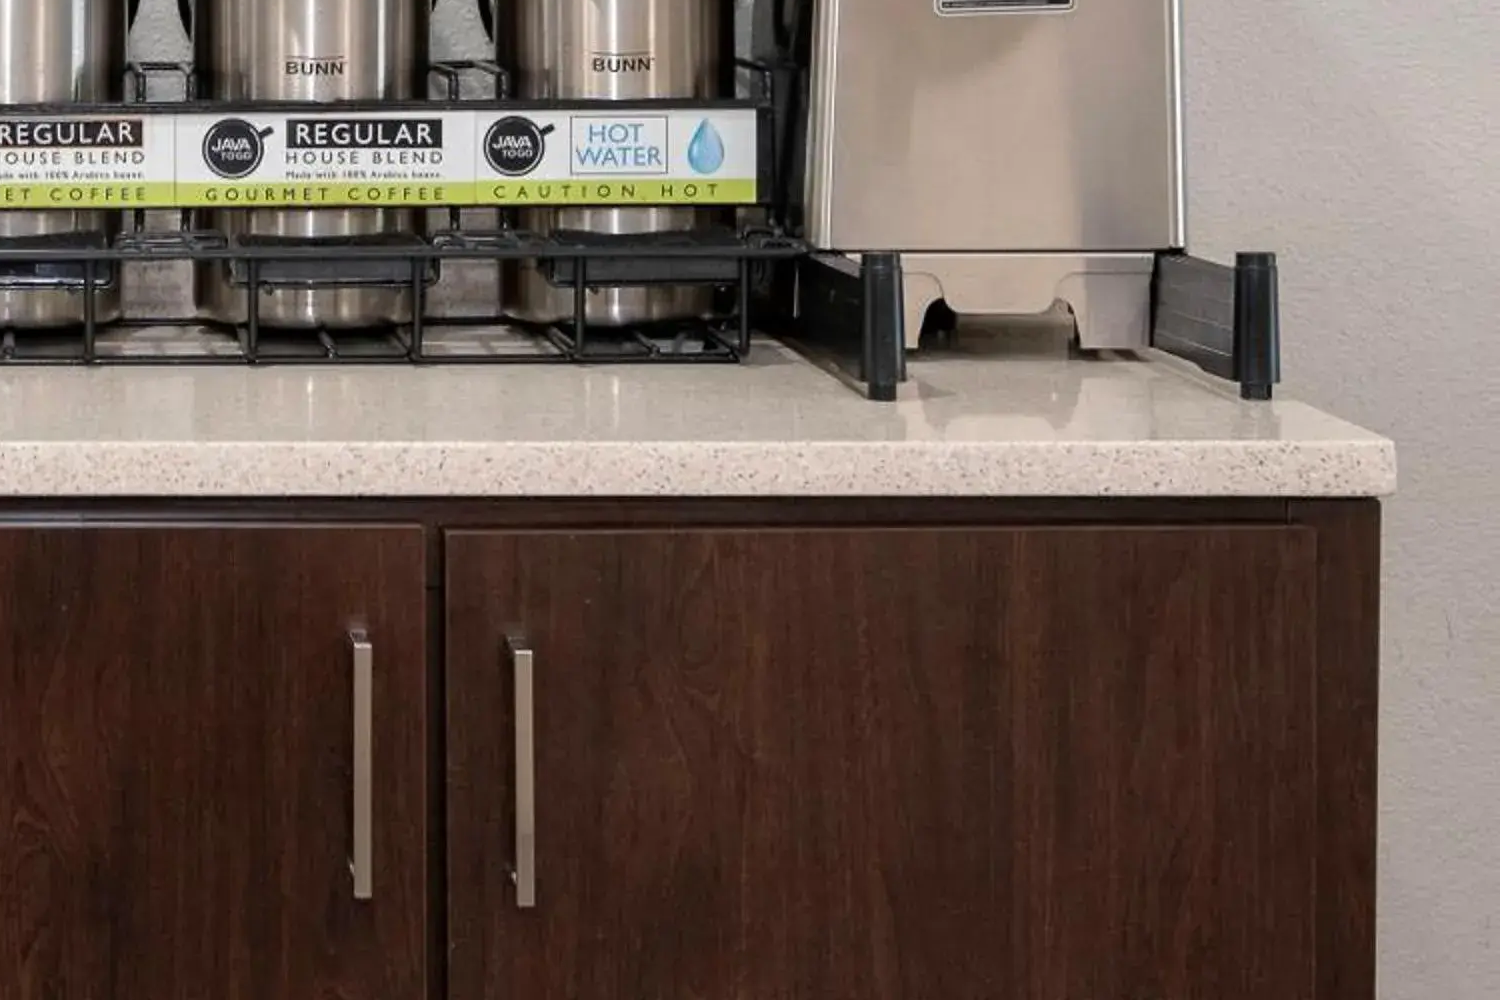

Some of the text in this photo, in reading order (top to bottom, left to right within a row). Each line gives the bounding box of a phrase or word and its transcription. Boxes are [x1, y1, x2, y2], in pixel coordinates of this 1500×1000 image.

[285, 61, 344, 75] BUNN
[592, 57, 651, 72] BUNN
[296, 123, 433, 145] REGULAR
[588, 123, 645, 143] HOT
[211, 138, 251, 150] JAVA
[492, 135, 532, 149] JAVA
[74, 151, 145, 165] BLEND
[285, 150, 444, 164] HOUSE BLEND
[576, 147, 662, 166] WATER
[49, 187, 146, 201] COFFEE
[205, 187, 444, 200] GOURMET COFFEE
[493, 183, 718, 199] CAUTION HOT
